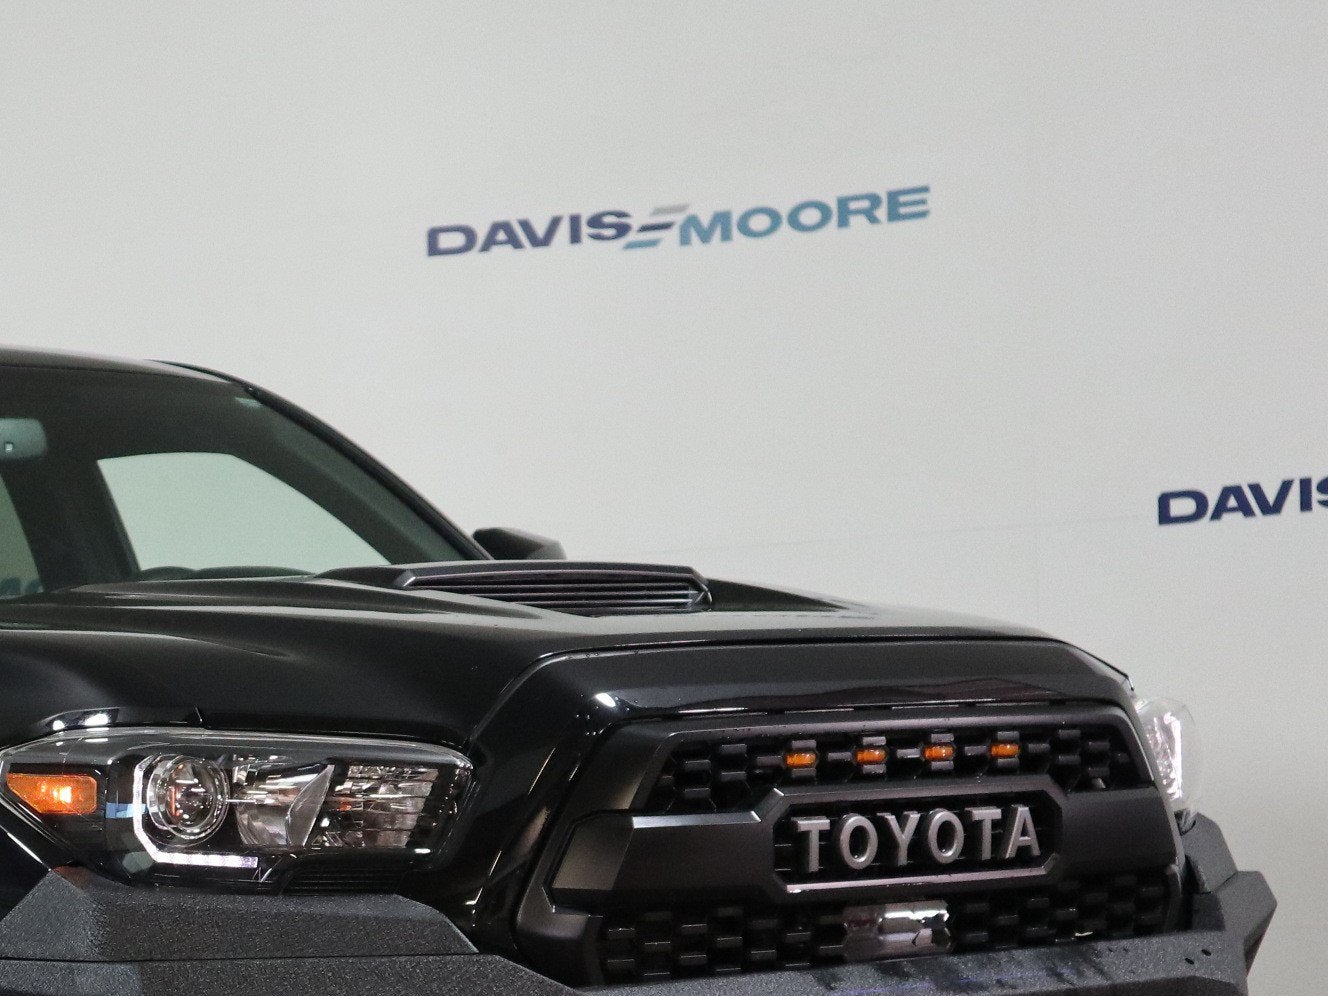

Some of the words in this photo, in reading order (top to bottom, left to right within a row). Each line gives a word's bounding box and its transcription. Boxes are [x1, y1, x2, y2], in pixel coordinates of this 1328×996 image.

[426, 209, 632, 257] DAVIS
[678, 185, 932, 248] MOORE
[1158, 475, 1328, 526] DAVI
[792, 804, 1041, 873] TOYOTA
